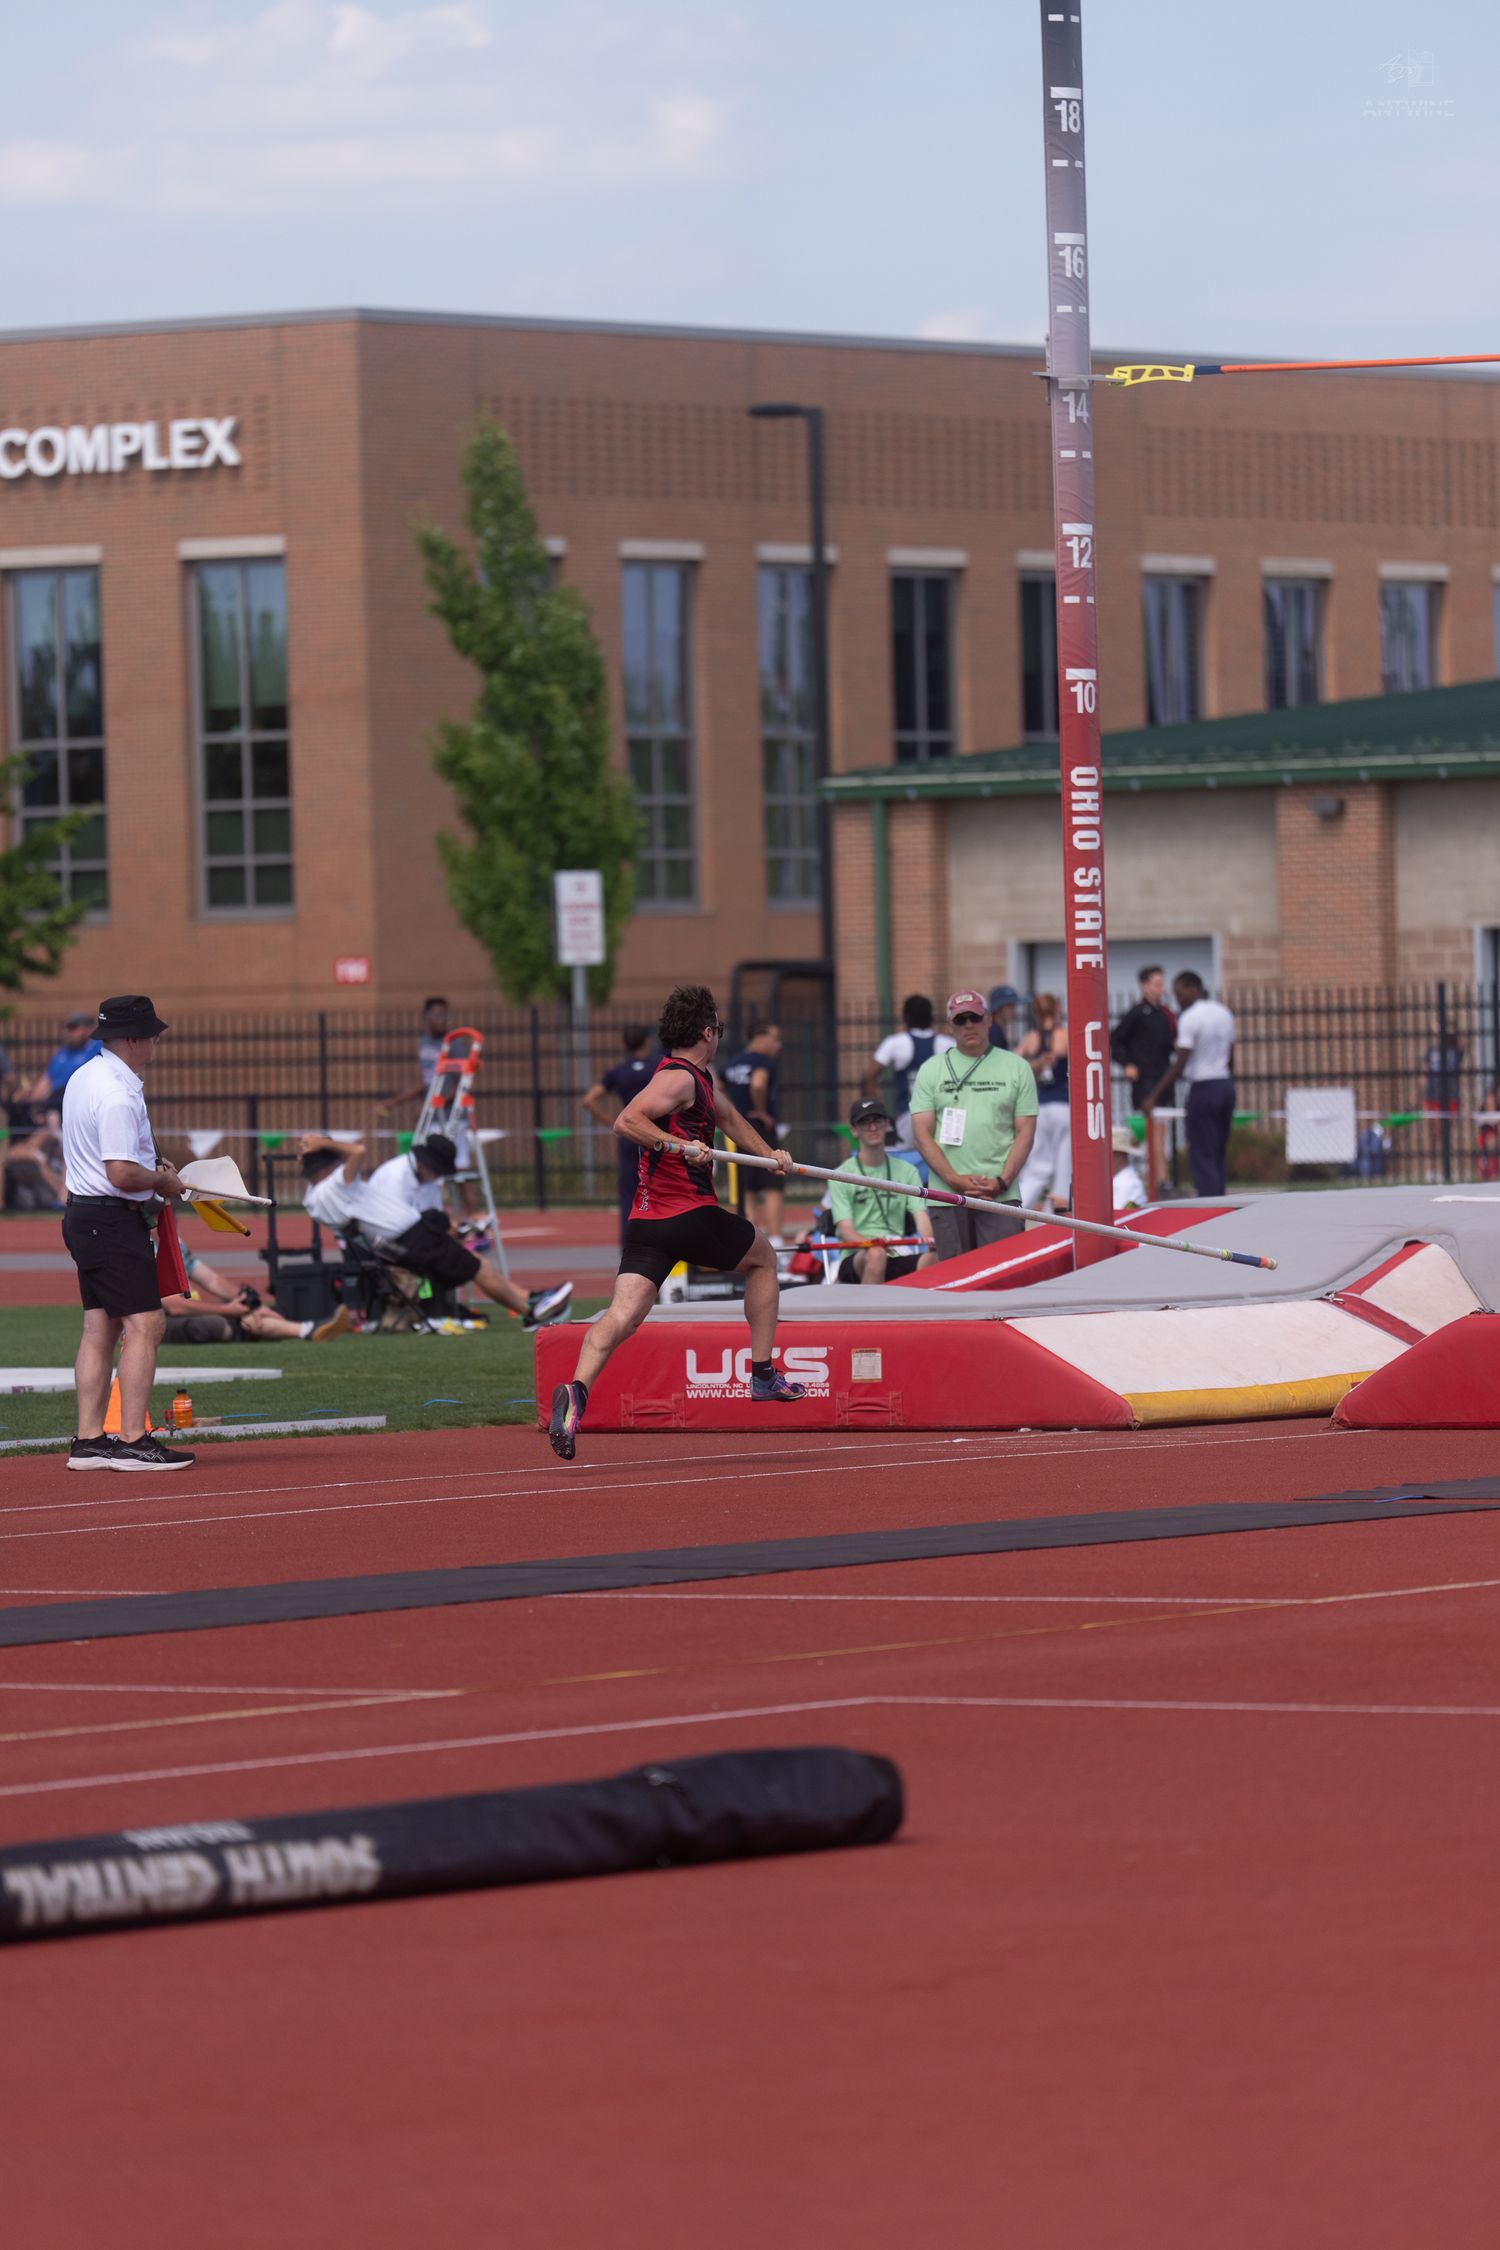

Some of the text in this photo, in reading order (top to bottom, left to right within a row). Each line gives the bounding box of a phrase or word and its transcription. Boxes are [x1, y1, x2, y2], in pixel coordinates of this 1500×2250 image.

[1054, 99, 1081, 133] 18
[1058, 245, 1085, 278] 16
[1062, 391, 1089, 424] 14
[0, 416, 241, 479] COMPLEX
[1066, 536, 1093, 568] 12
[1070, 681, 1096, 714] 10
[1070, 766, 1104, 969] OHIO STATE
[1084, 1021, 1106, 1140] UCS
[4, 1835, 382, 1926] SOUTH CENTRAL
